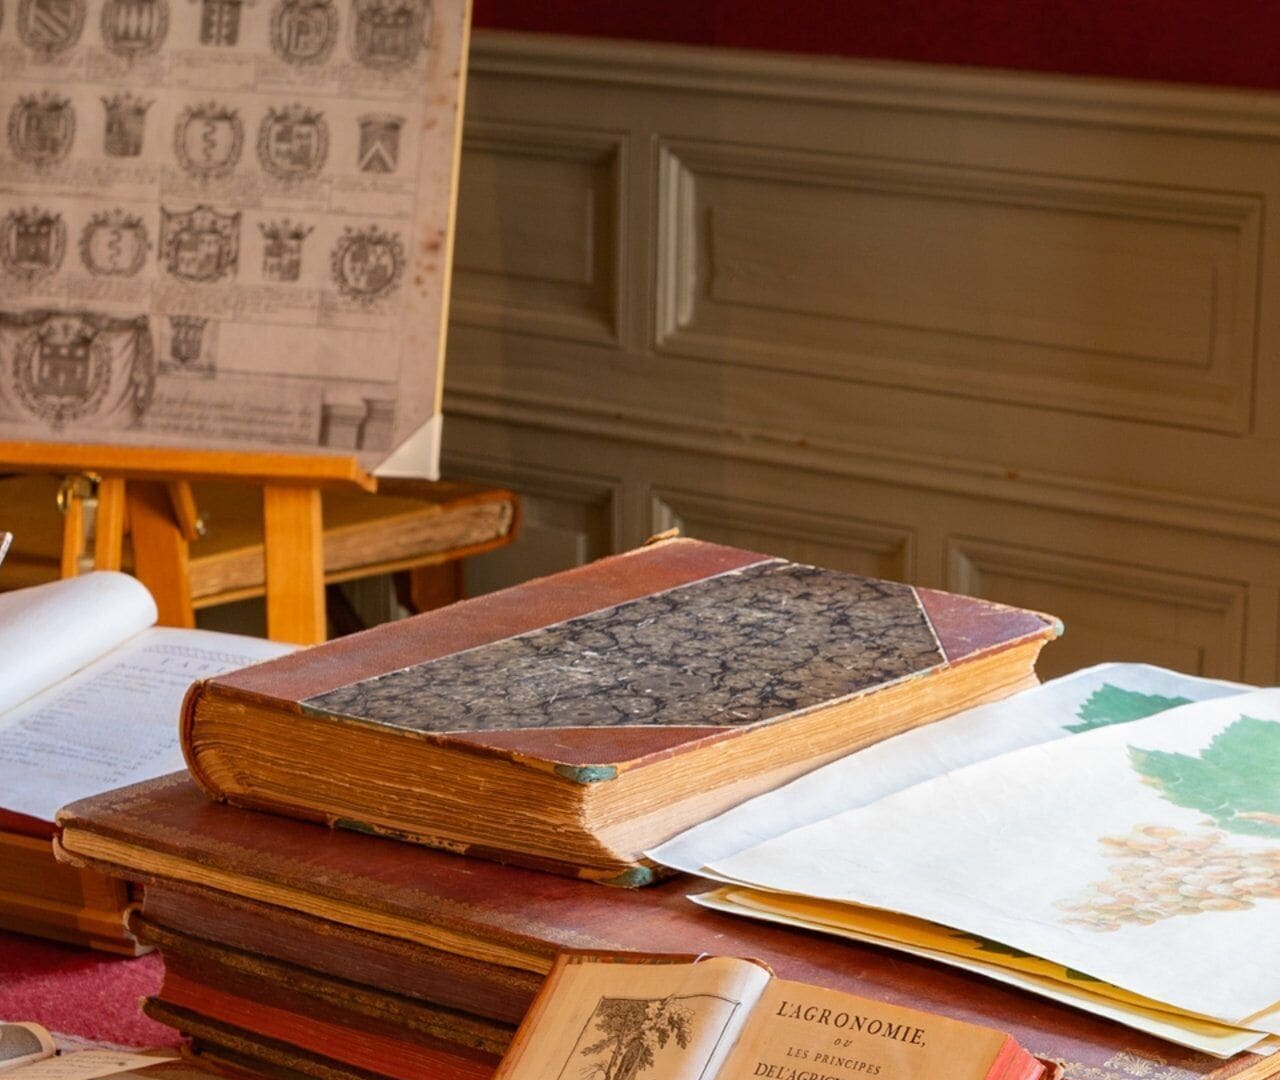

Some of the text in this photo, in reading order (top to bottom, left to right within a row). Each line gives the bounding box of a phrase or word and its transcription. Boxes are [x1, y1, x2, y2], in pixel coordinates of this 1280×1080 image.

[776, 1001, 926, 1047] L'AGRONOMIE,
[786, 1047, 881, 1075] LES PRINCIPES
